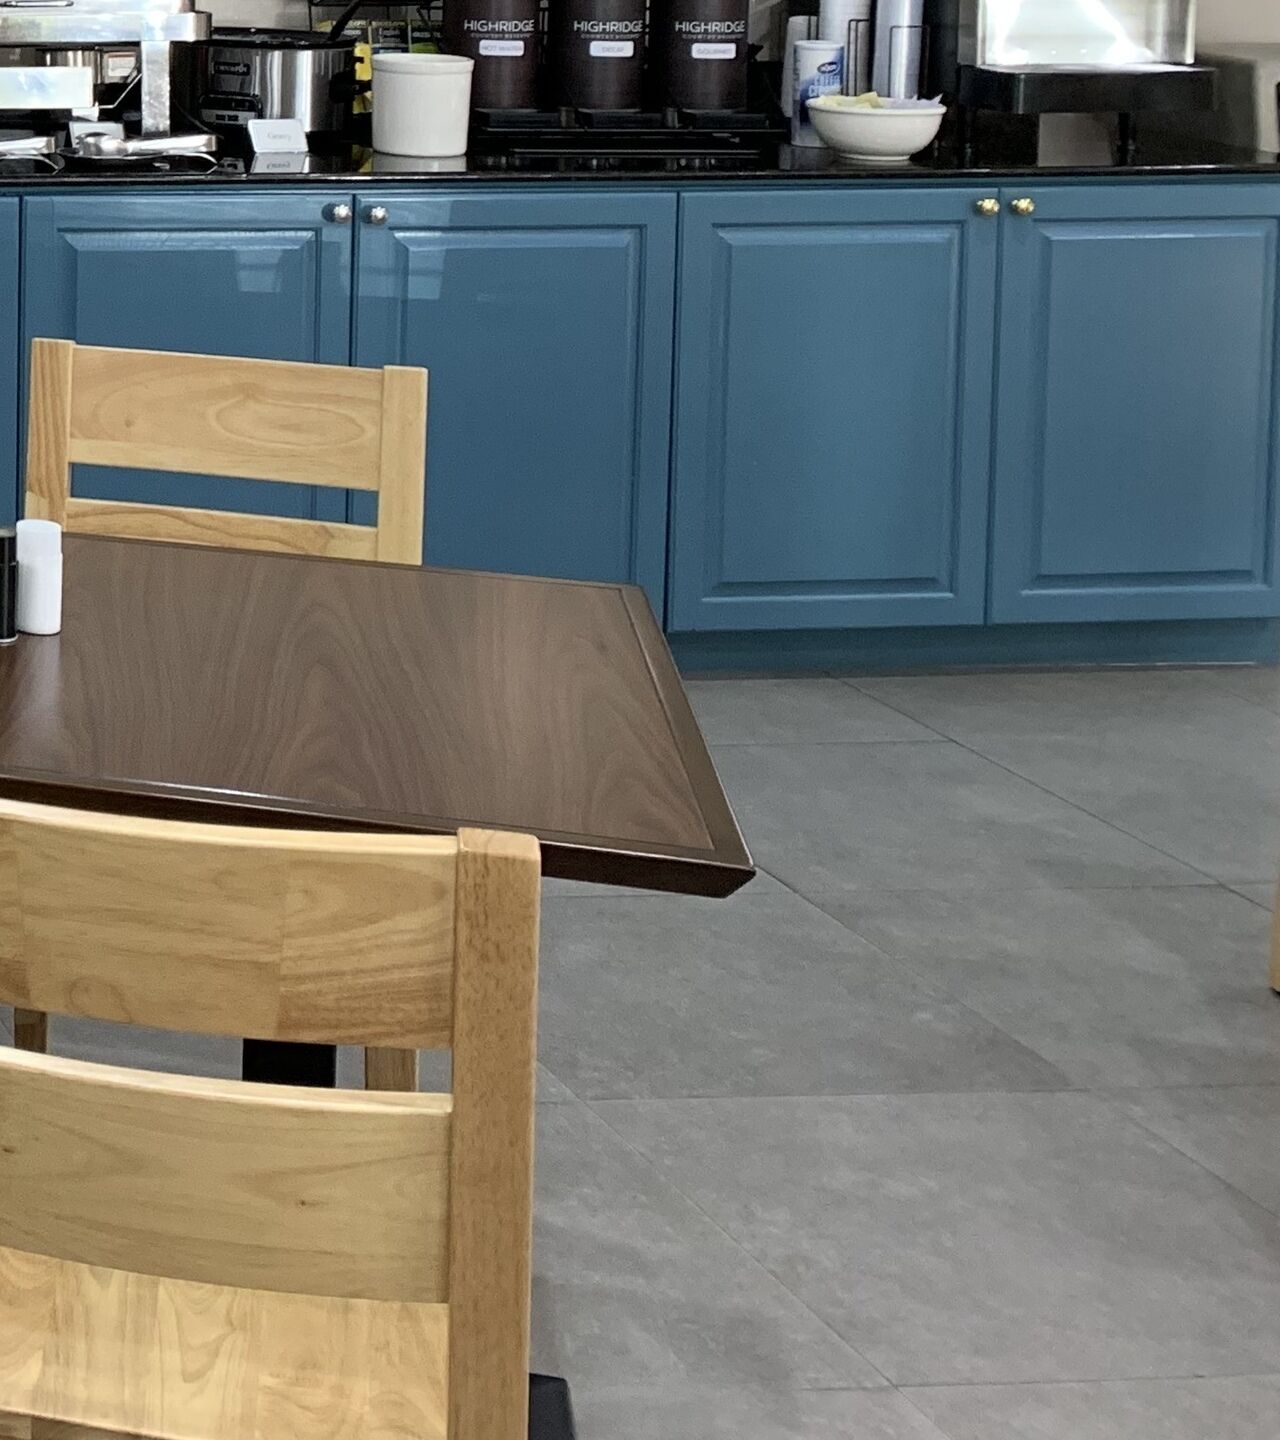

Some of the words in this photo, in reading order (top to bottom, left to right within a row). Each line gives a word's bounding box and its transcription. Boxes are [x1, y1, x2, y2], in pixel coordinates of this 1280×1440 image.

[463, 19, 535, 32] HIGHRIDGE
[573, 20, 643, 33] HIGHRIDGE
[675, 21, 746, 33] HIGHRIDGE
